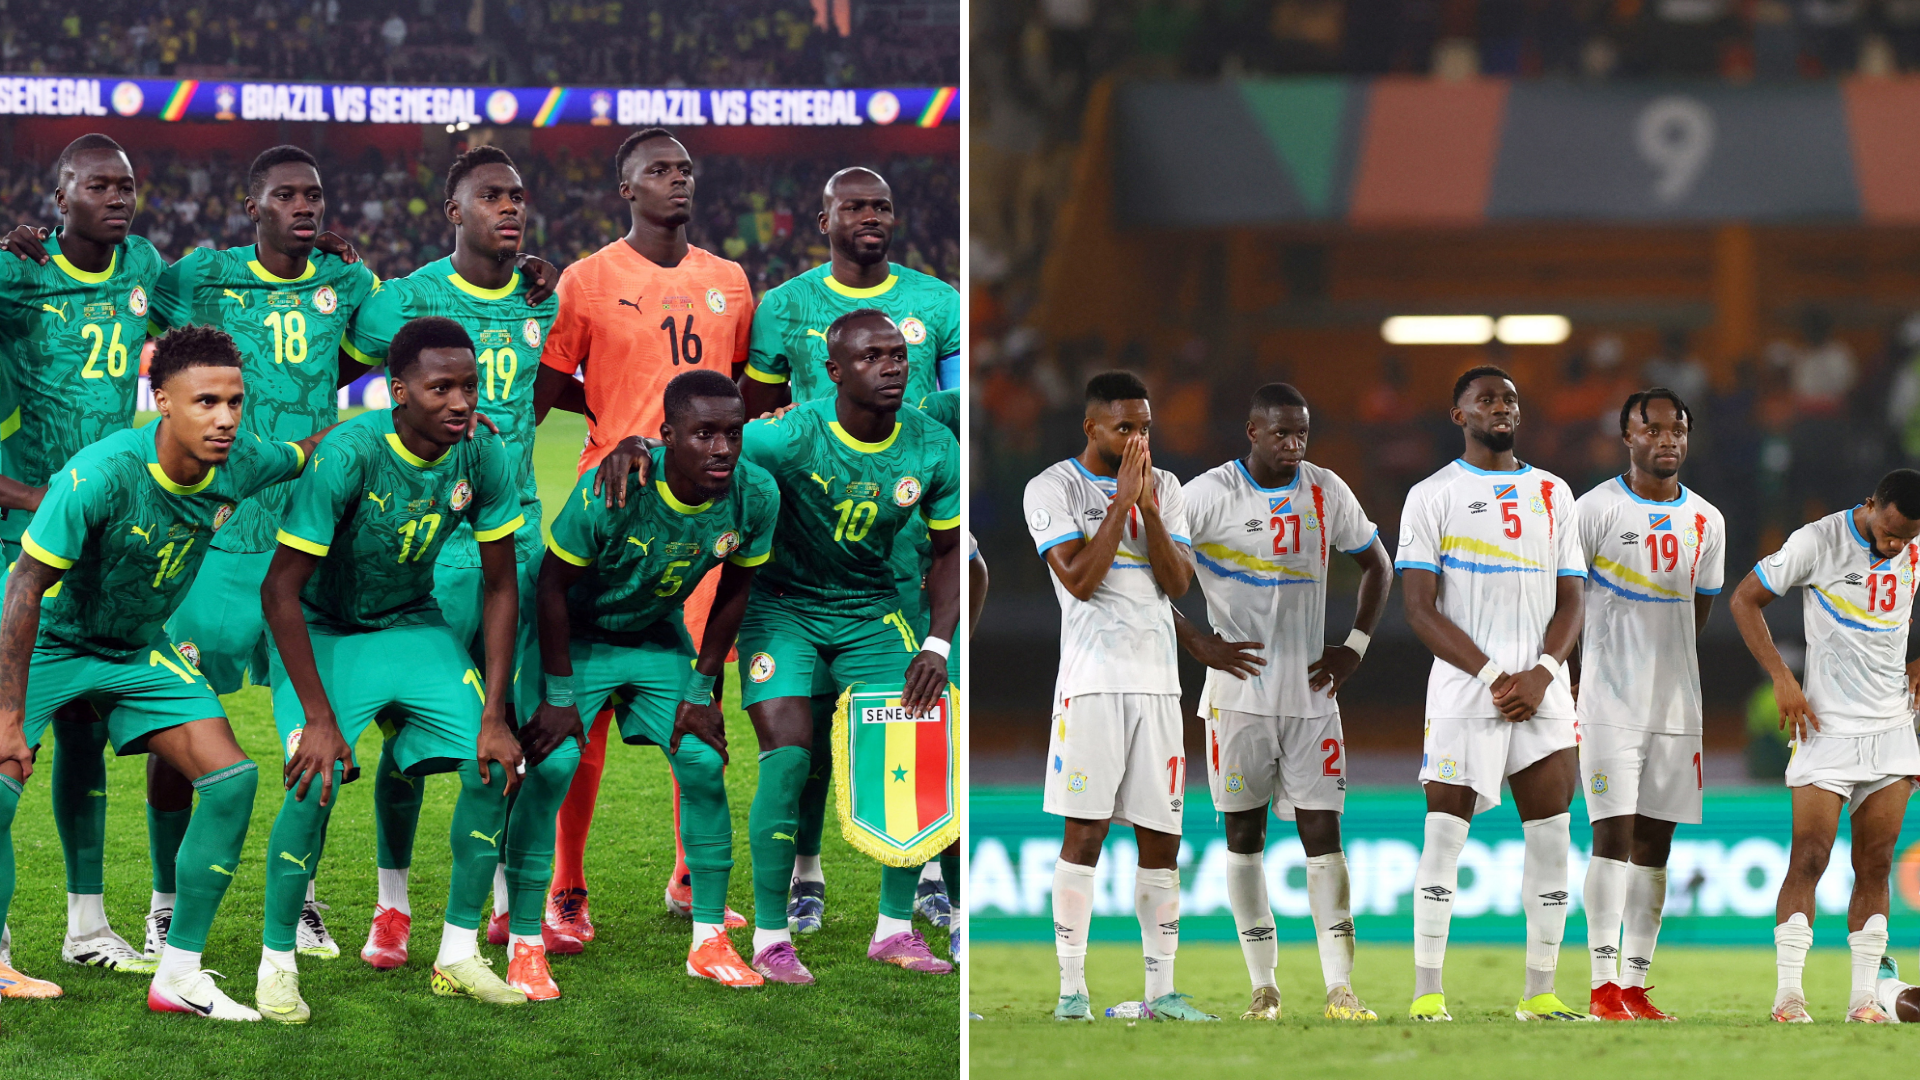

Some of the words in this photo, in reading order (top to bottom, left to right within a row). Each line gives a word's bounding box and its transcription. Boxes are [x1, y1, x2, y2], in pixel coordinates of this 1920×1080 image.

[0, 77, 107, 116] SENEGAL
[241, 84, 329, 122] BRAZIL
[332, 87, 366, 122] VS
[370, 87, 481, 124] SENEGAL
[617, 89, 707, 125] BRAZIL
[710, 90, 747, 126] VS
[750, 90, 863, 126] SENEGAL
[1637, 97, 1716, 201] 9
[81, 322, 127, 379] 26
[264, 311, 307, 364] 18
[661, 314, 703, 366] 16
[478, 347, 517, 400] 19
[398, 513, 441, 563] 17
[834, 498, 878, 542] 10
[1270, 514, 1300, 556] 27
[1500, 501, 1522, 540] 5
[1645, 533, 1679, 573] 19
[655, 560, 691, 597] 5
[1865, 573, 1897, 612] 13
[969, 838, 1246, 916] AFIA
